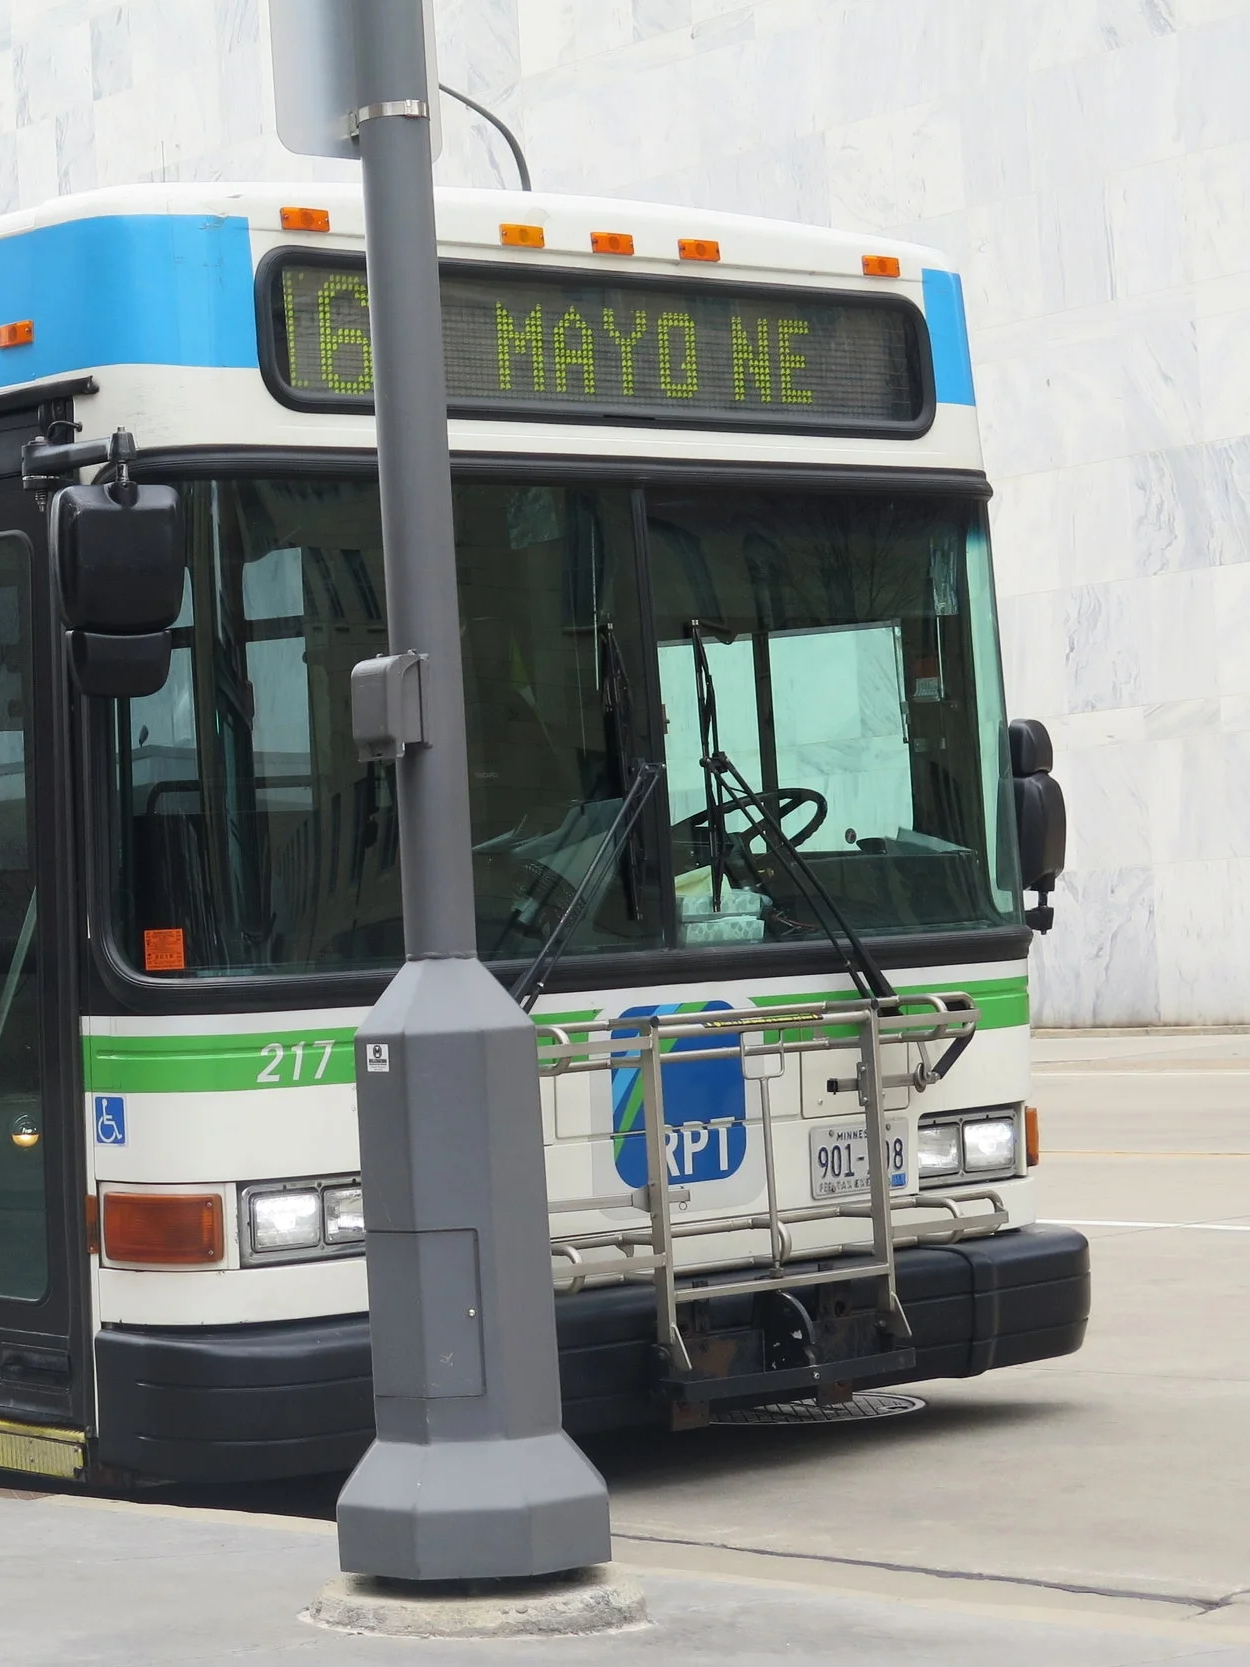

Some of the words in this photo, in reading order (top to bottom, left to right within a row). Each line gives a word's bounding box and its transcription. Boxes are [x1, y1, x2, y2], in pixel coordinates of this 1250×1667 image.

[495, 301, 699, 399] MAYO
[732, 316, 813, 404] NE
[256, 1039, 336, 1082] 217
[817, 1137, 903, 1180] 901-8
